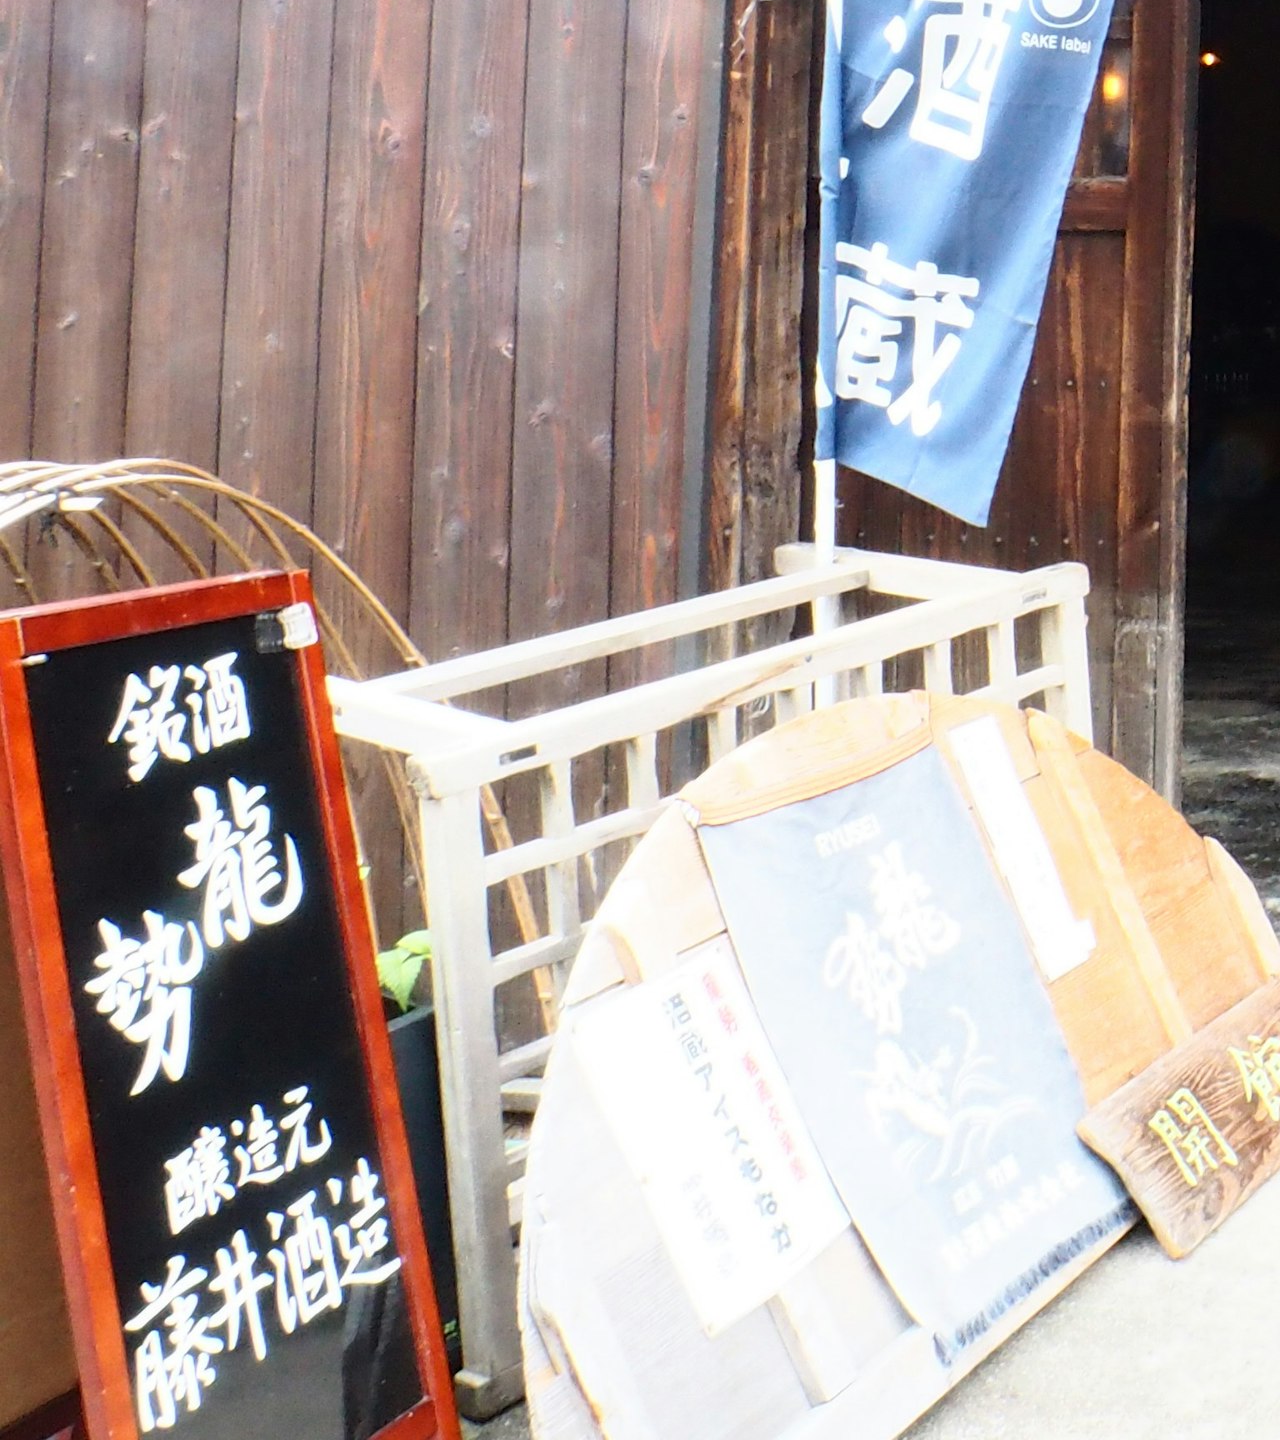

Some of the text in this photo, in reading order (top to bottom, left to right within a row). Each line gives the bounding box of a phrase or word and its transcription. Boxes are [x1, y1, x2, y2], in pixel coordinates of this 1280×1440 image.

[1020, 31, 1092, 55] SAKE label
[108, 652, 251, 782] 銘酒
[84, 776, 303, 1097] 龍勢
[123, 1157, 403, 1433] 藤井酒造
